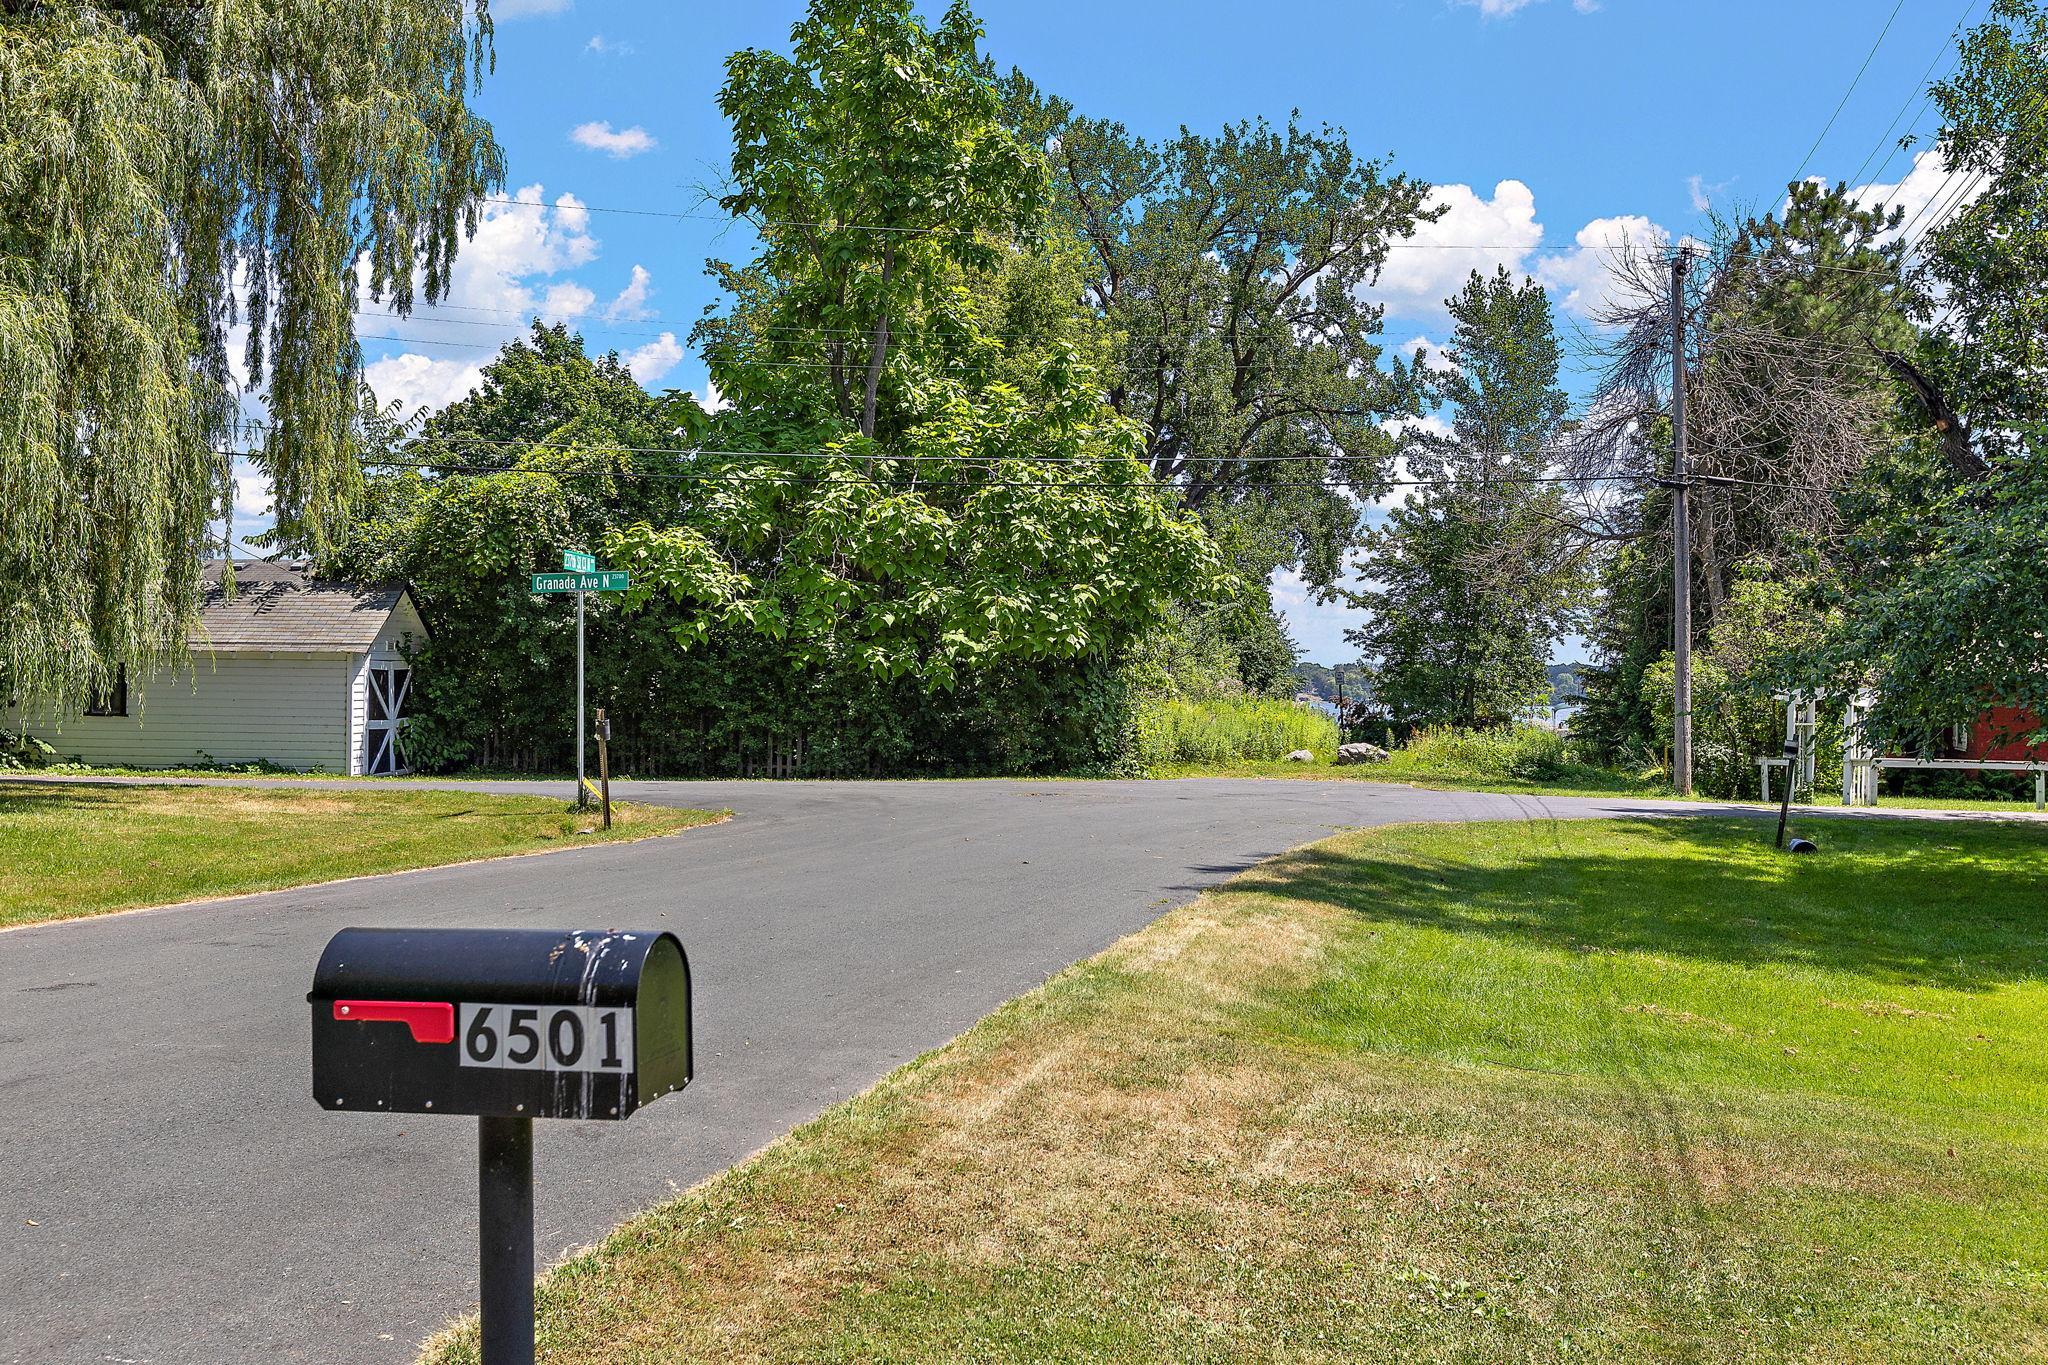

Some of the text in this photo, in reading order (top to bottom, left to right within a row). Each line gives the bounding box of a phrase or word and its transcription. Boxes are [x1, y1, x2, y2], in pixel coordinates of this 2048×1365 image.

[536, 574, 609, 590] Granada Ave N
[466, 1007, 622, 1067] 6501
